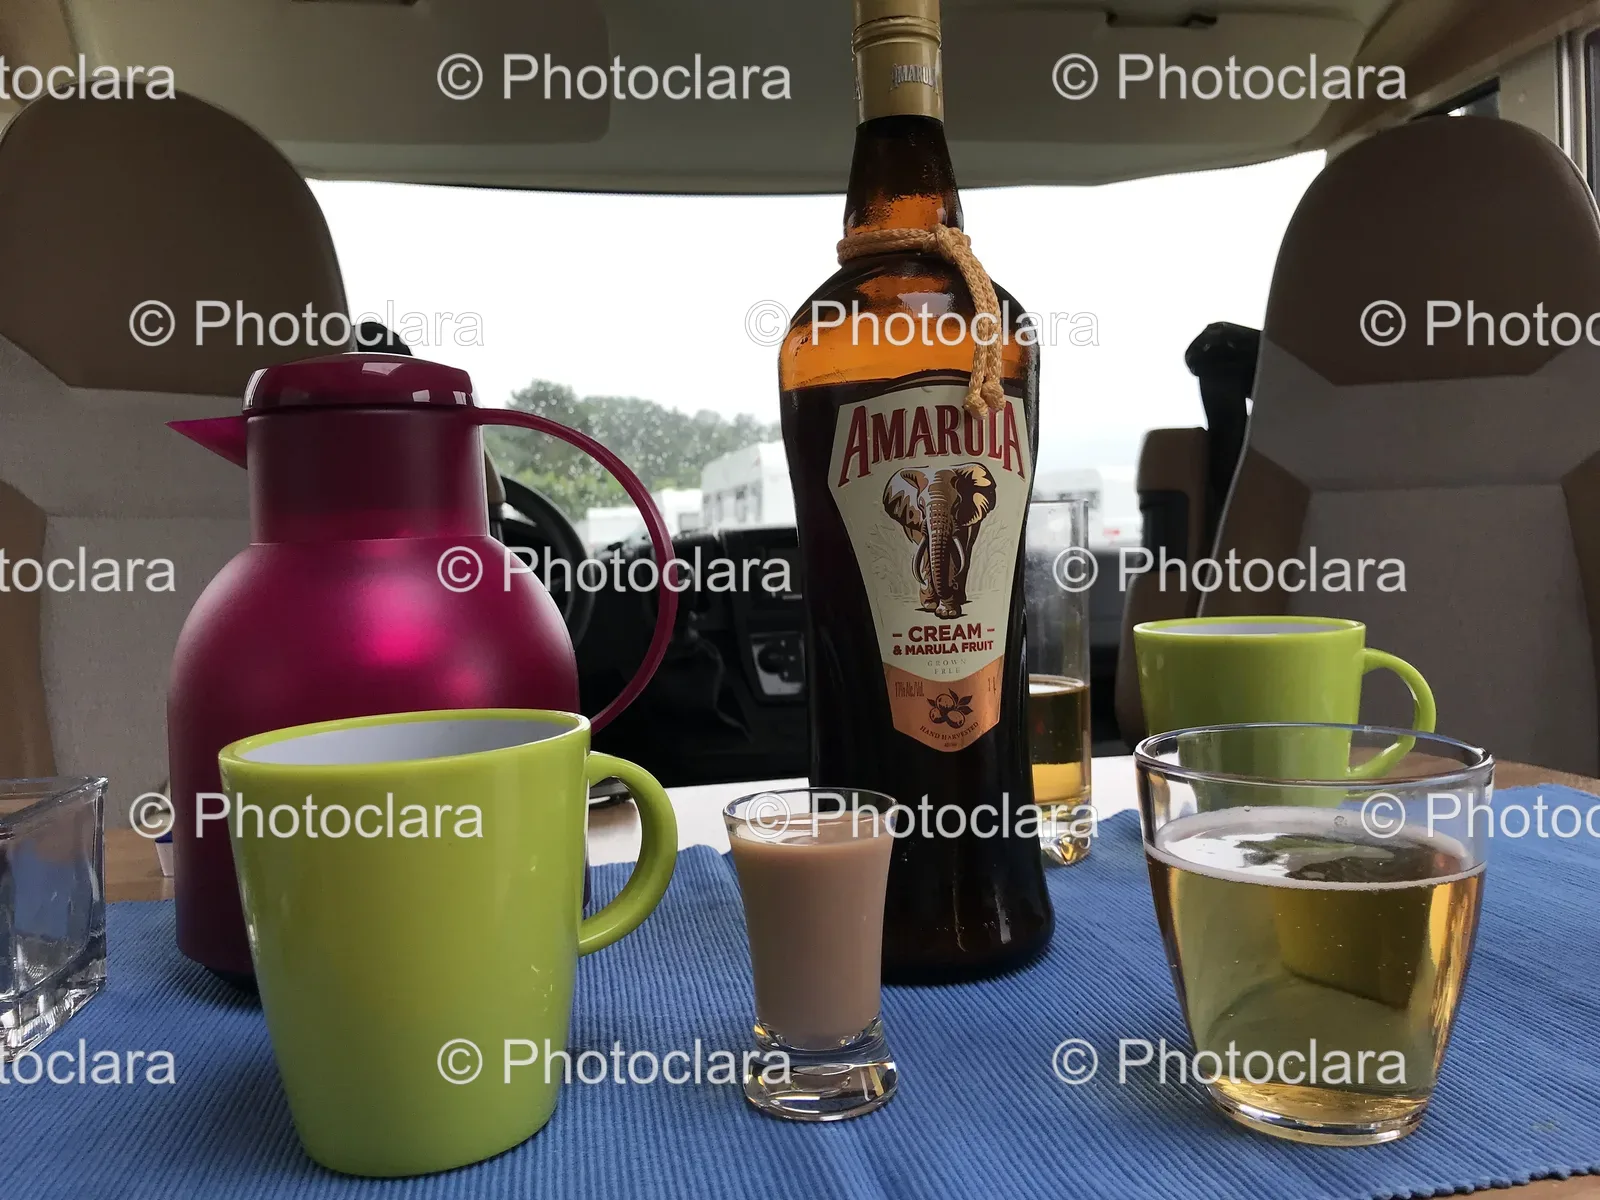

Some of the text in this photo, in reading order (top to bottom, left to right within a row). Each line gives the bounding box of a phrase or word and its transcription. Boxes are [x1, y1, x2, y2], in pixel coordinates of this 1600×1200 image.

[838, 400, 1025, 487] AMARULA
[908, 622, 982, 642] CREAM
[892, 640, 994, 656] & MARULA FRUIT
[927, 659, 967, 667] GROWN
[919, 721, 979, 741] HAND HARVESTED
